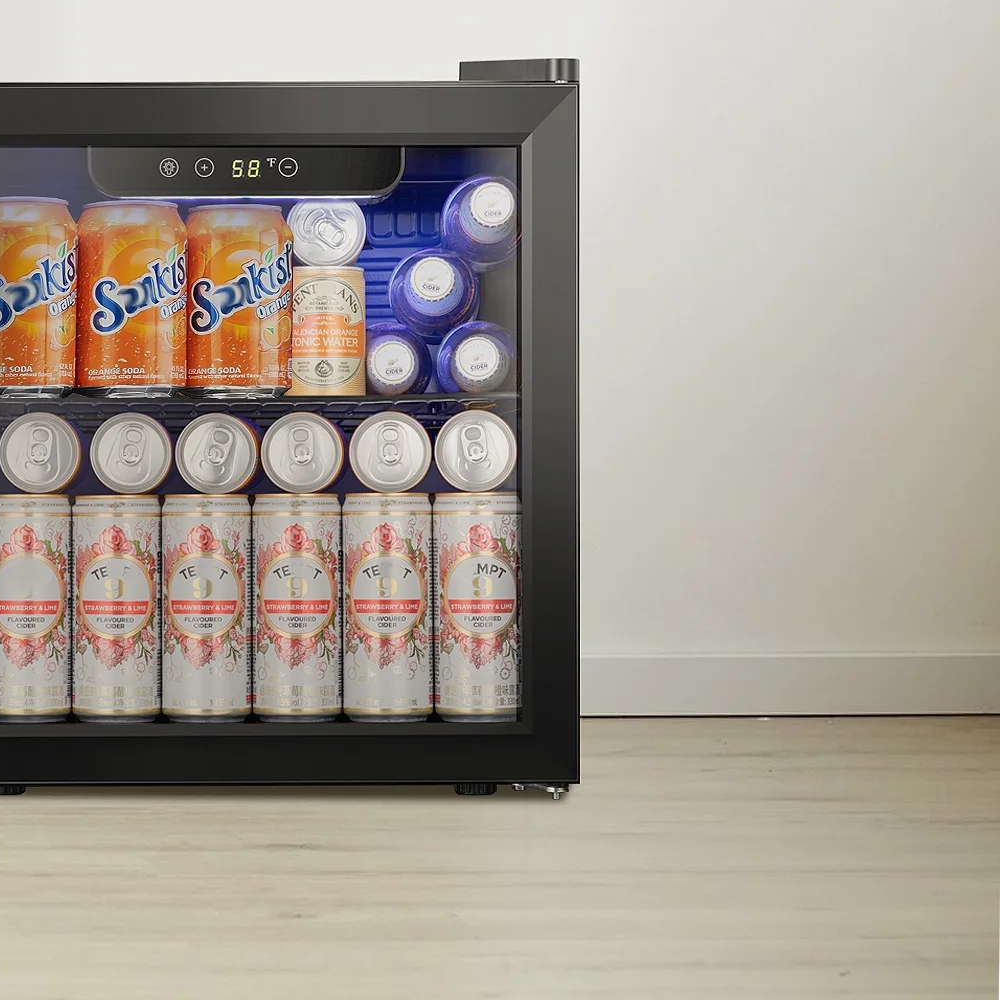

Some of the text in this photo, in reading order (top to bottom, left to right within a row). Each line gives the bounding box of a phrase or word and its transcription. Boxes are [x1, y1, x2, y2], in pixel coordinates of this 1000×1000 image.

[232, 159, 260, 178] 58
[421, 283, 440, 292] CIDER
[329, 328, 358, 337] ORANGE
[322, 337, 358, 348] WATER
[9, 365, 33, 373] SODA
[88, 368, 121, 376] ORANGE
[188, 367, 216, 375] ORANGE
[217, 366, 242, 374] SODA
[385, 367, 403, 375] CIDER
[469, 363, 488, 371] CIDER
[104, 578, 125, 599] 9
[192, 577, 213, 598] 9
[287, 576, 308, 598] 9
[376, 576, 398, 598] 9
[472, 576, 493, 598] 9
